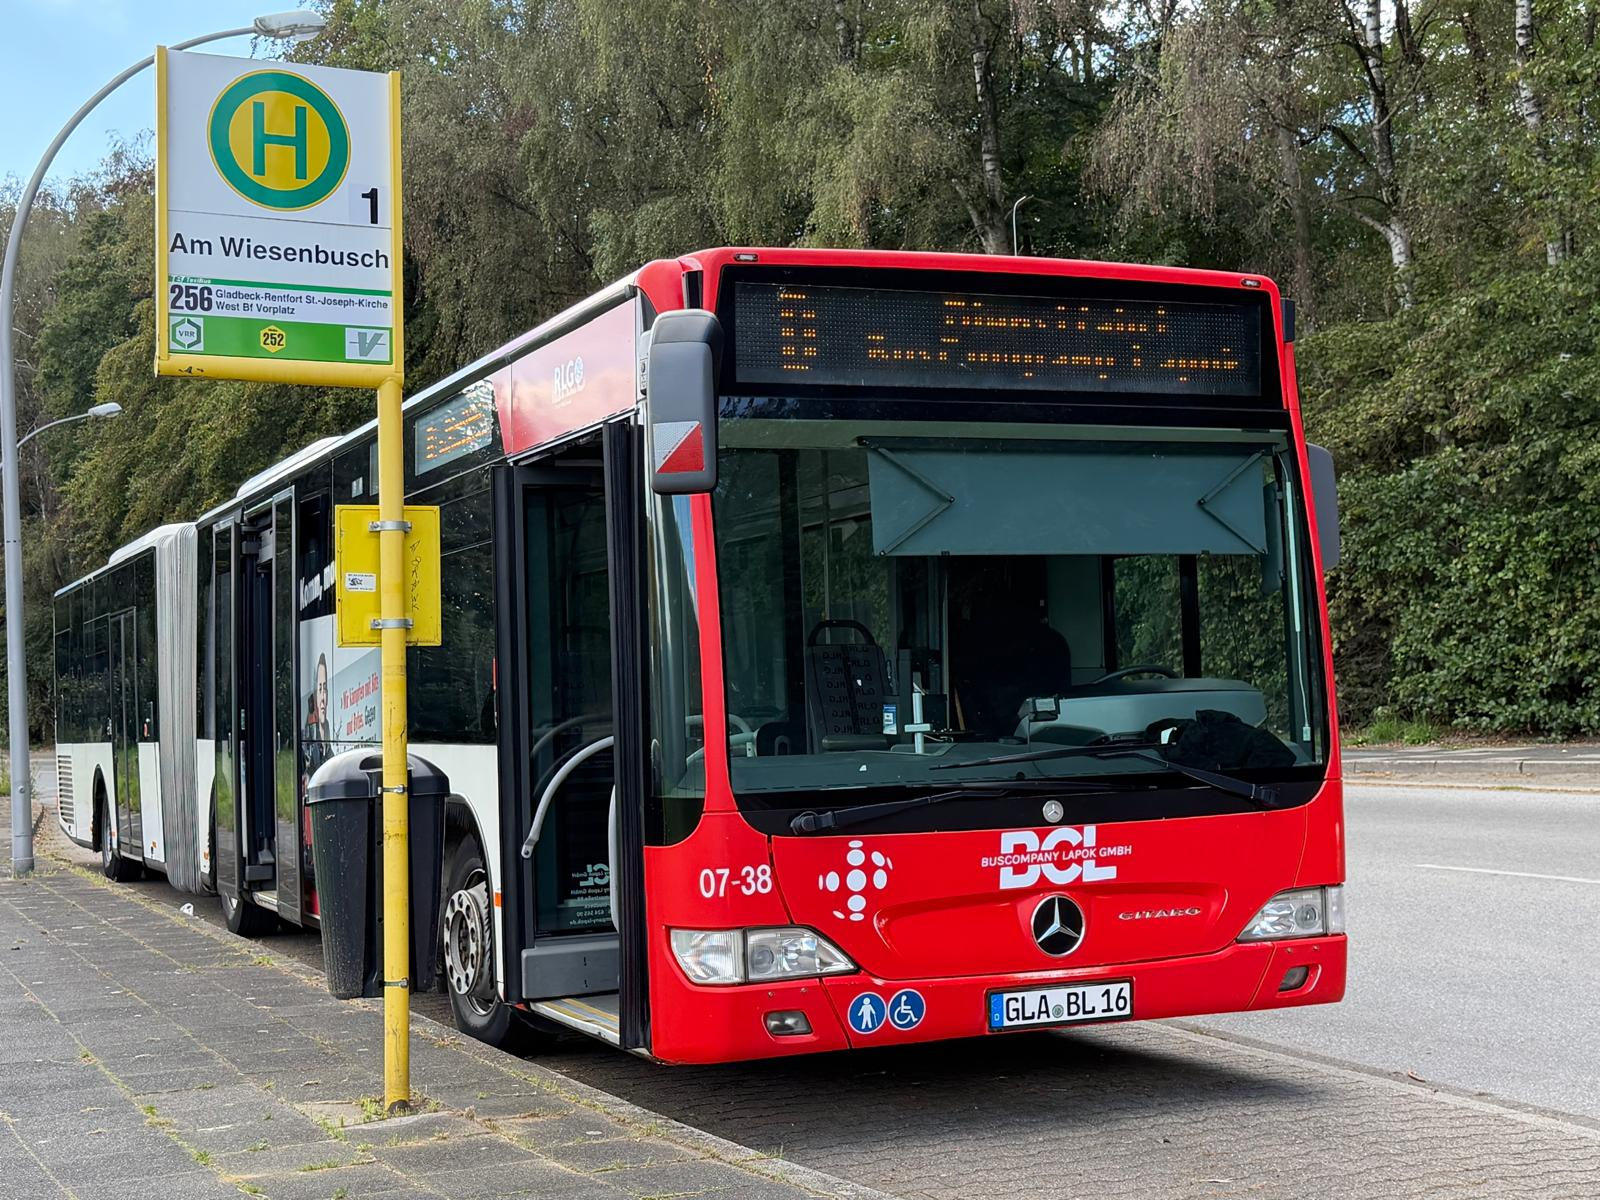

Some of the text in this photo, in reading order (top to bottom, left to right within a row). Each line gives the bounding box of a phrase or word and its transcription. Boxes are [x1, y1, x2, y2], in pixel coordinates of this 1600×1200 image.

[253, 101, 307, 180] H
[361, 187, 379, 225] 1
[170, 232, 389, 269] Am Wiesenbusch
[170, 284, 389, 312] 256 Gladbeck-Rentfort St.-Joseph-Kirche
[215, 301, 296, 315] West Bf Vorplatz
[178, 330, 196, 338] VRR
[262, 332, 285, 347] 252
[981, 845, 1133, 868] BUSCOMPANY LAPOK GMBH
[999, 825, 1117, 890] BCL
[699, 863, 773, 899] 07-38
[1005, 986, 1128, 1022] GLA BL 16
